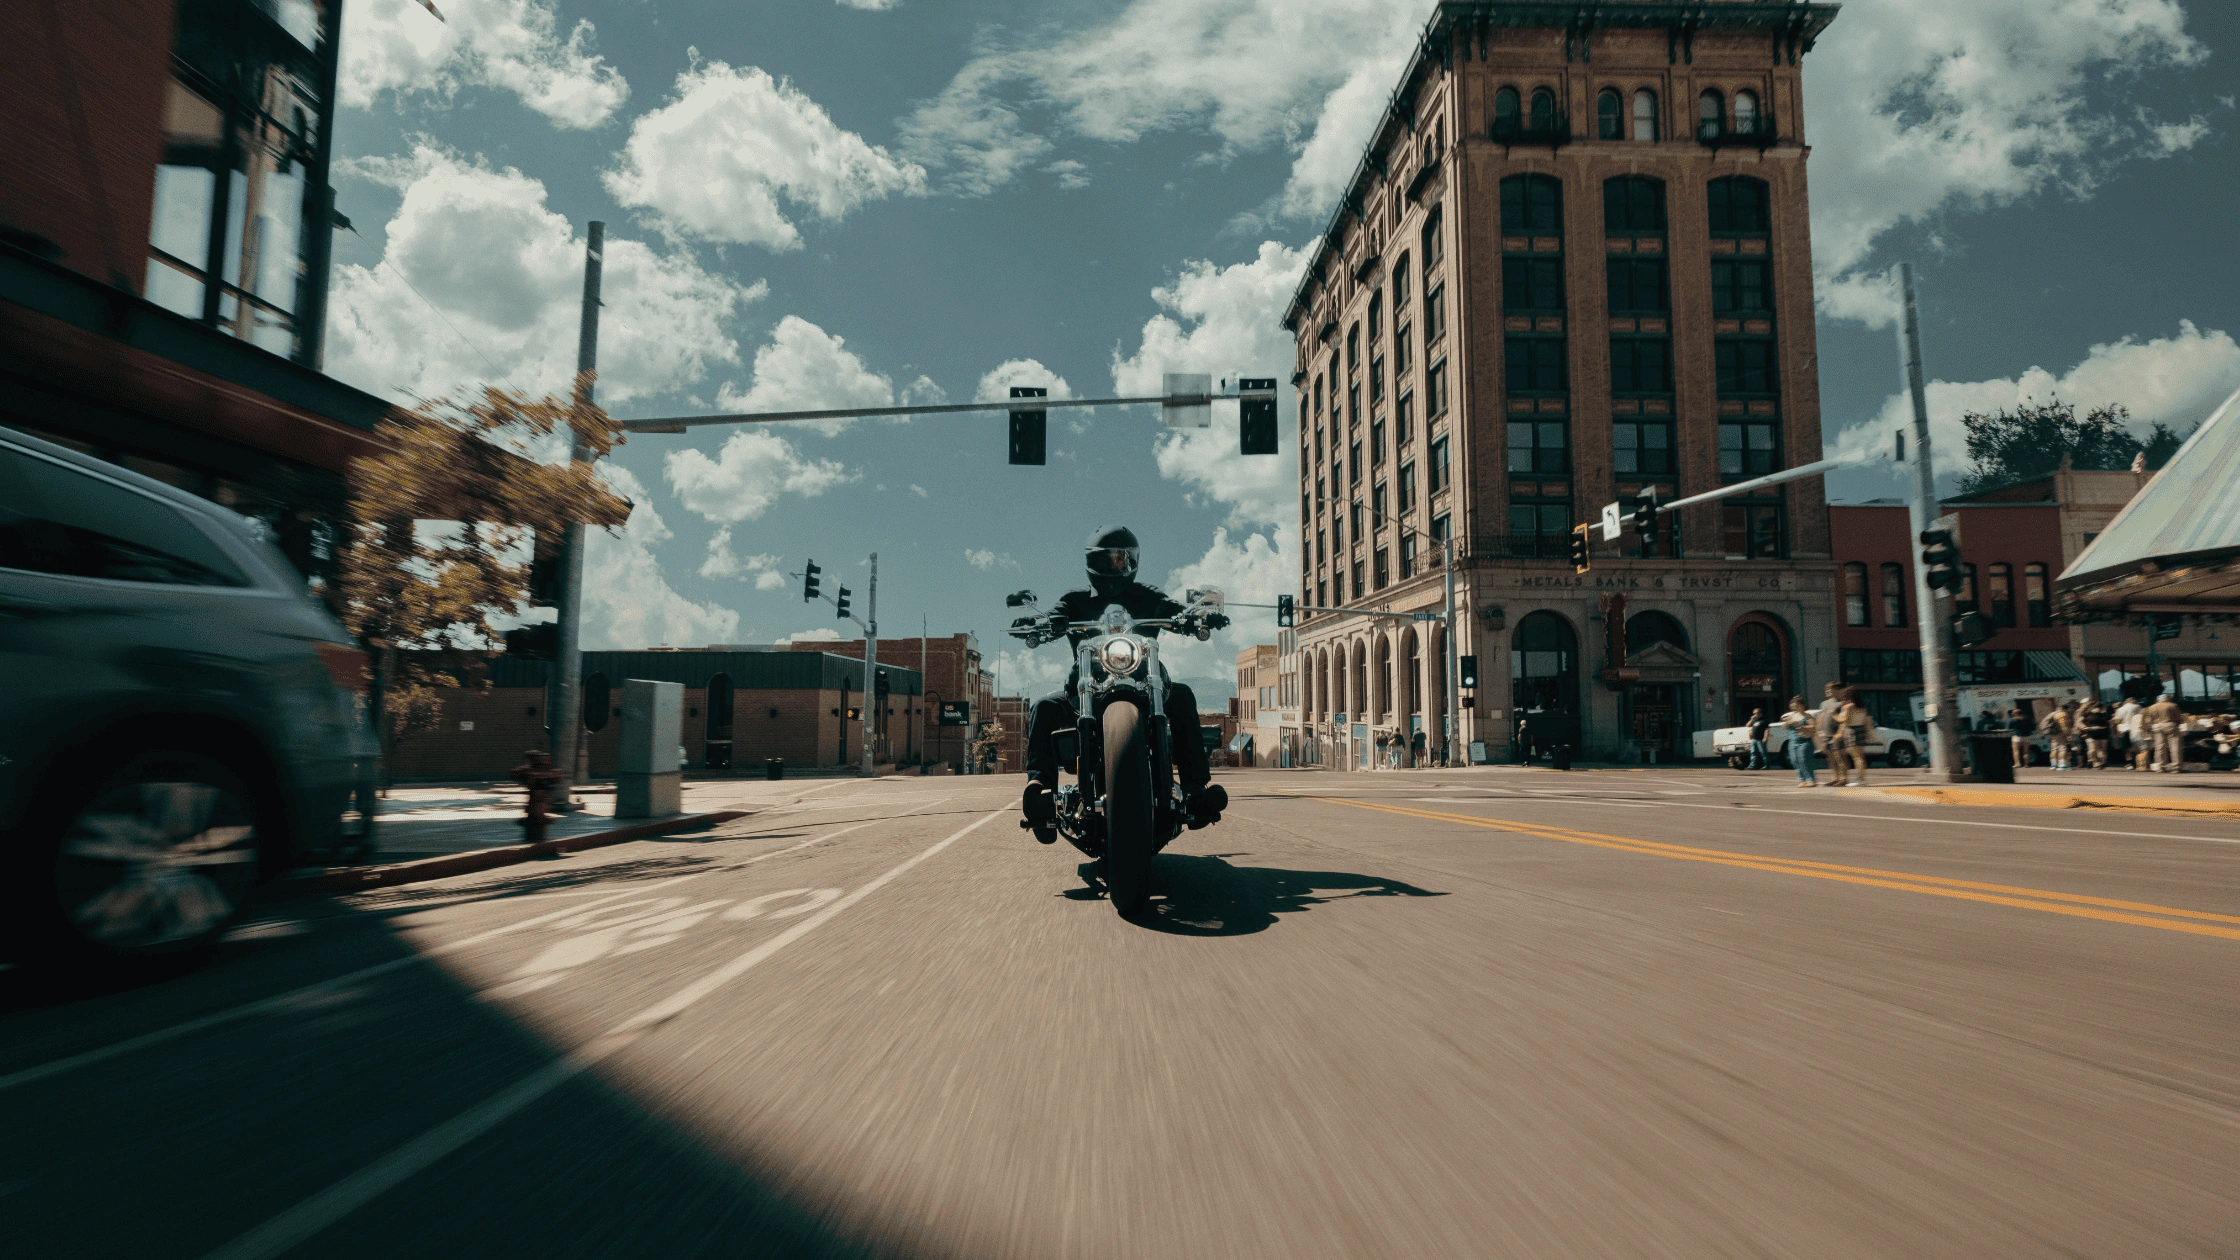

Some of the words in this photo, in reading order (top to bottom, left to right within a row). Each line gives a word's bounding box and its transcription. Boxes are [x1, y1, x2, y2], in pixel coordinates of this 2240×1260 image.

[1522, 576, 1582, 587] METALS
[1596, 577, 1639, 587] BANK
[1655, 578, 1664, 587] &
